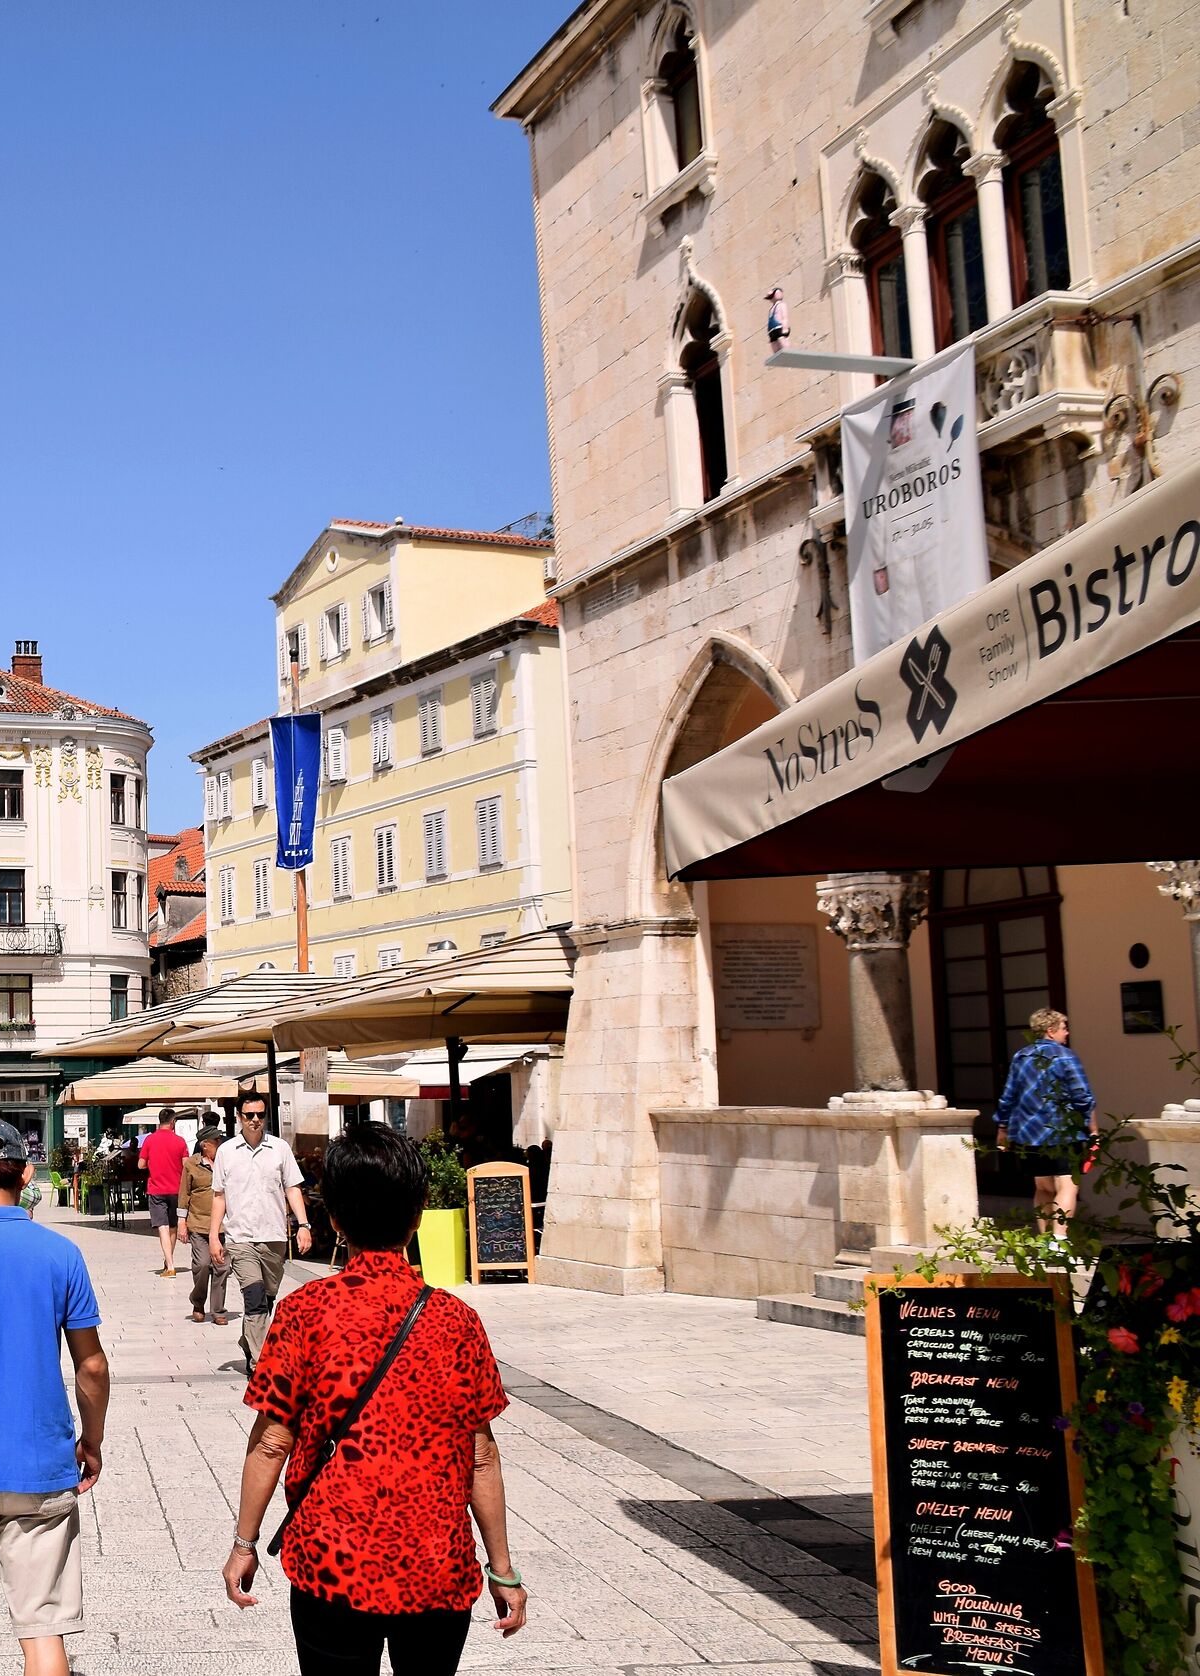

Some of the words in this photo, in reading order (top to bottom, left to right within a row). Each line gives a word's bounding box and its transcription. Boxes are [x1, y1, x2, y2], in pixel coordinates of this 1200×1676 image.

[862, 458, 961, 520] UROBOROS
[1030, 520, 1200, 660] Bistro
[986, 608, 1010, 631] One
[979, 633, 1015, 664] Family
[988, 661, 1018, 689] Show
[482, 1244, 523, 1253] WELCOME
[900, 1300, 956, 1319] WELLNES
[966, 1306, 1000, 1319] MENU
[910, 1327, 954, 1338] CEREALS
[960, 1330, 983, 1342] WITH
[988, 1333, 1028, 1344] YOGURT
[906, 1340, 954, 1350] CAPUCCINO
[960, 1343, 972, 1352] OR
[908, 1350, 933, 1360] FRESH
[936, 1352, 971, 1362] ORANGE
[976, 1354, 1005, 1362] JUICE
[910, 1371, 979, 1389] BREAKFAST
[986, 1378, 1019, 1390] MENU
[900, 1394, 927, 1406] TOAST
[932, 1398, 975, 1407] SANDWICH
[904, 1416, 929, 1424] FRESH
[934, 1417, 970, 1426] ORANGE
[976, 1418, 1003, 1427] JUICE
[968, 1408, 991, 1417] TEA
[908, 1438, 950, 1450] SWEET
[953, 1440, 1008, 1454] BREAKFAST
[1016, 1446, 1052, 1459] MENU
[910, 1458, 950, 1469] STRUDEL
[912, 1470, 962, 1479] CAPUCCINO
[967, 1472, 978, 1480] OR
[979, 1472, 1002, 1481] TEA
[911, 1478, 937, 1488] FRESH
[941, 1481, 974, 1490] ORANGE
[978, 1483, 1009, 1492] JUICE
[916, 1502, 970, 1517] OMELET
[974, 1507, 1012, 1522] MENU
[910, 1523, 952, 1534] OMELET
[909, 1536, 960, 1548] CAPUCCINO
[981, 1544, 1006, 1555] TEA
[908, 1546, 932, 1557] FRESH
[937, 1551, 968, 1562] ORANGE
[975, 1555, 1001, 1564] JUICE
[938, 1580, 976, 1595] GOOD
[954, 1596, 1022, 1620] MOURNING
[934, 1611, 960, 1628] WITH
[971, 1616, 987, 1629] NO
[995, 1622, 1041, 1639] STRESS
[943, 1628, 1031, 1652] BREAKFAST
